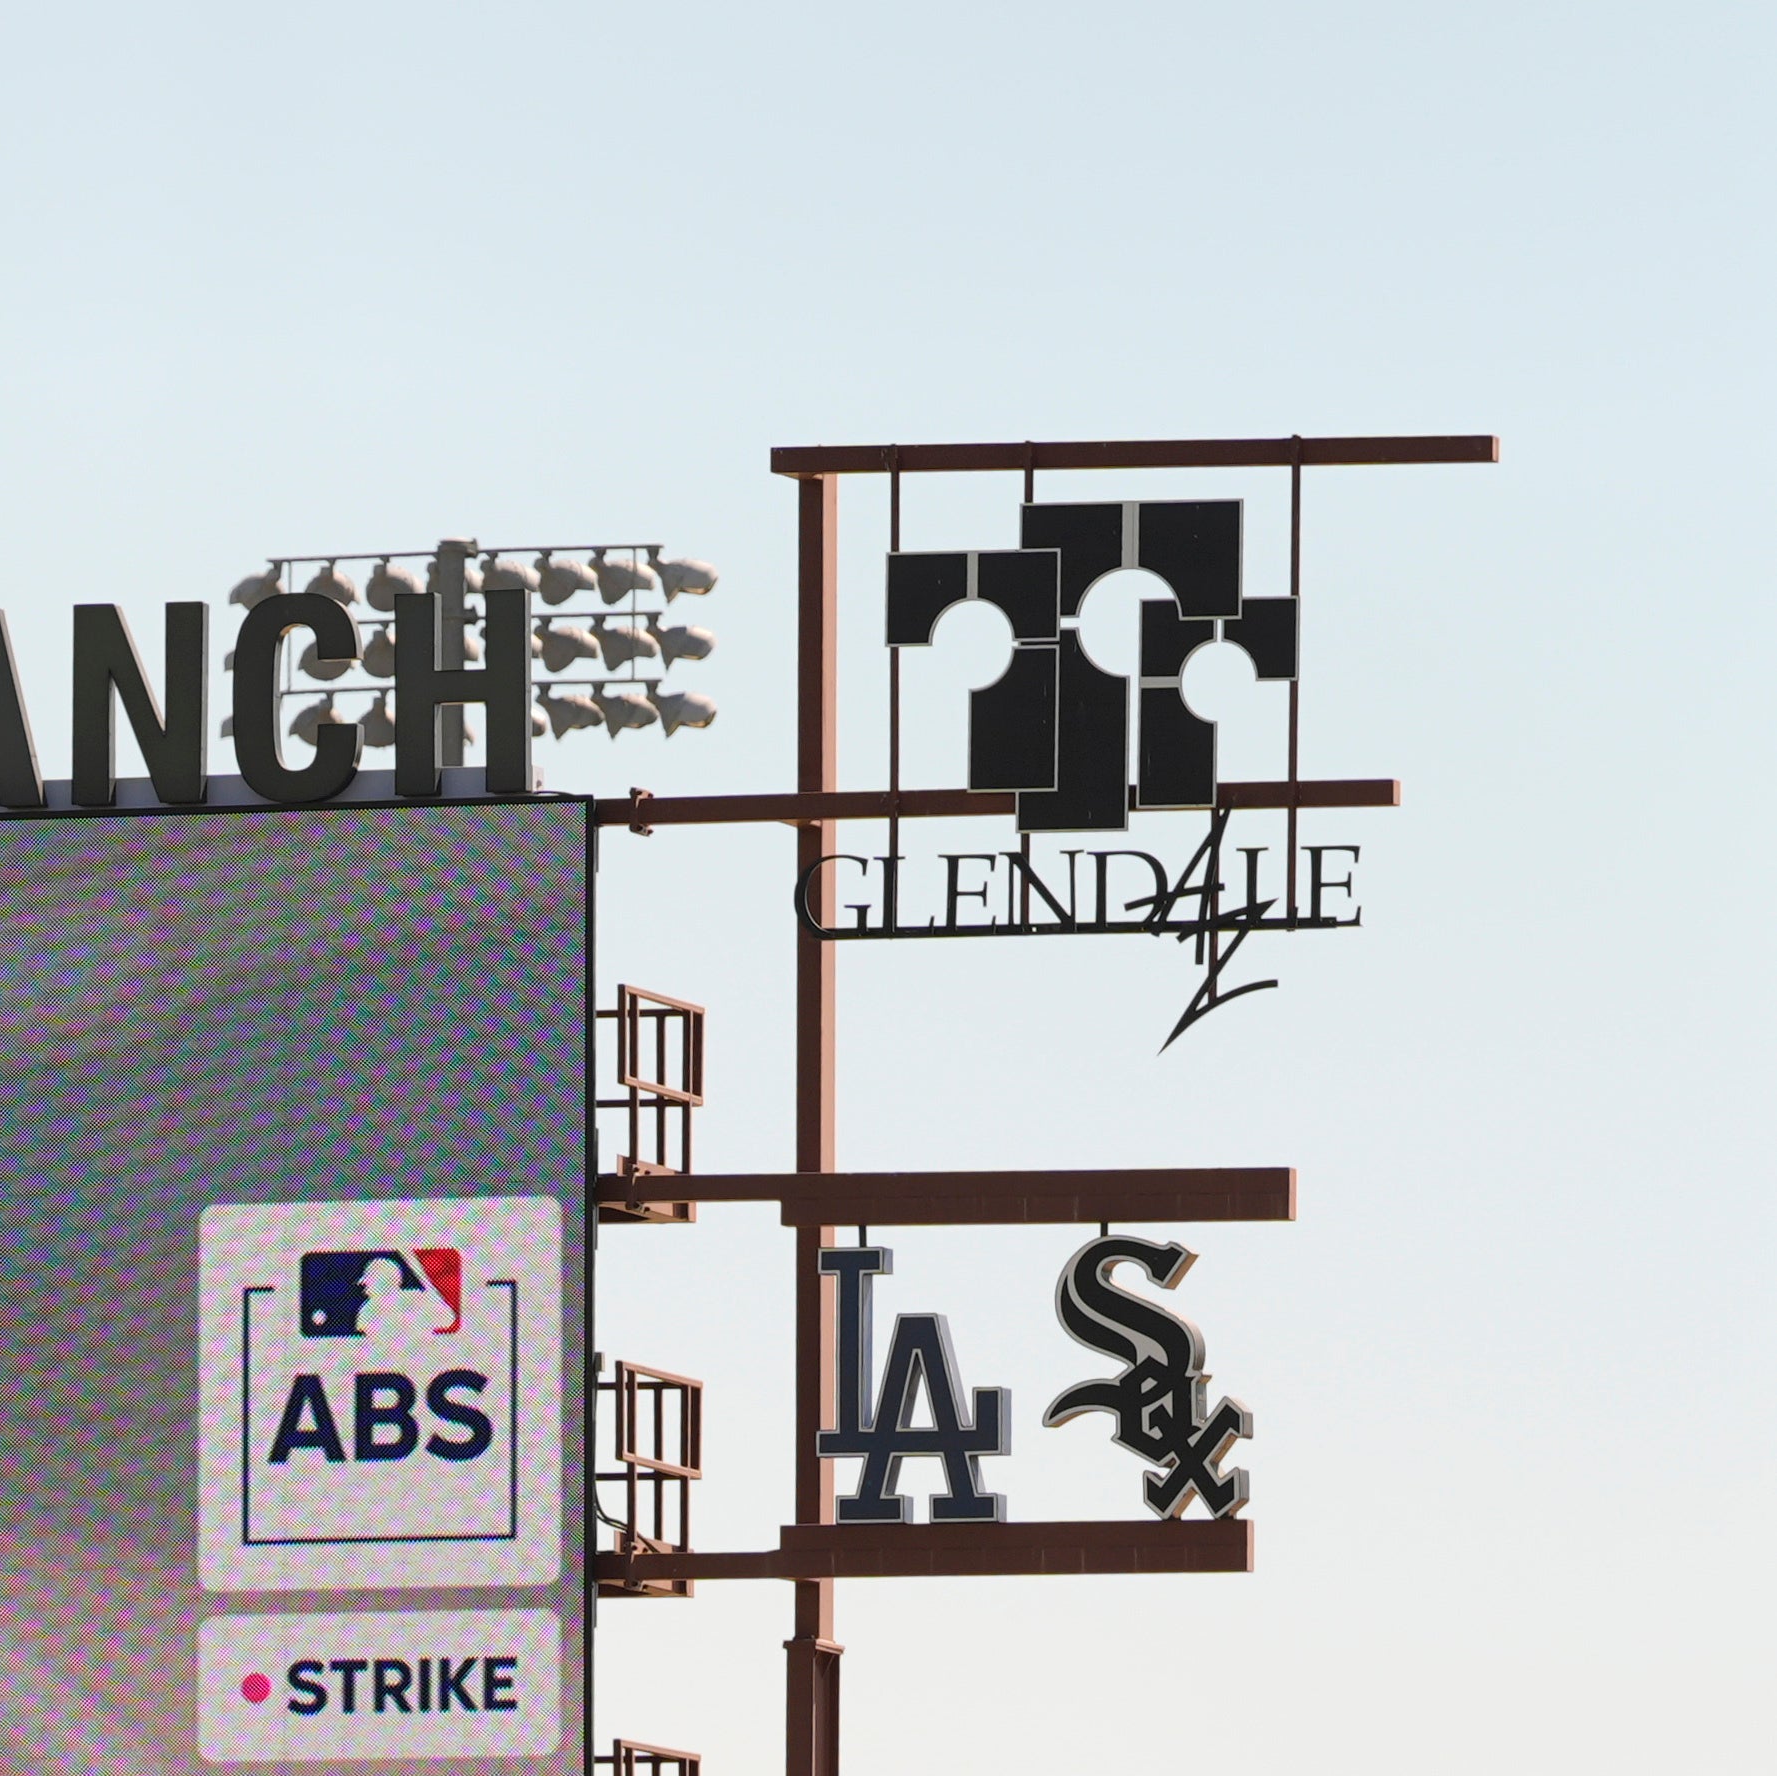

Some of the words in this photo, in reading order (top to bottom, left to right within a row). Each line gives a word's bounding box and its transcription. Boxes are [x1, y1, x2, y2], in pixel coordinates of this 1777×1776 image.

[794, 808, 1363, 965] GLENDALE
[267, 1369, 495, 1464] ABS
[816, 1247, 1012, 1524] LA
[286, 1656, 518, 1715] STRIKE
